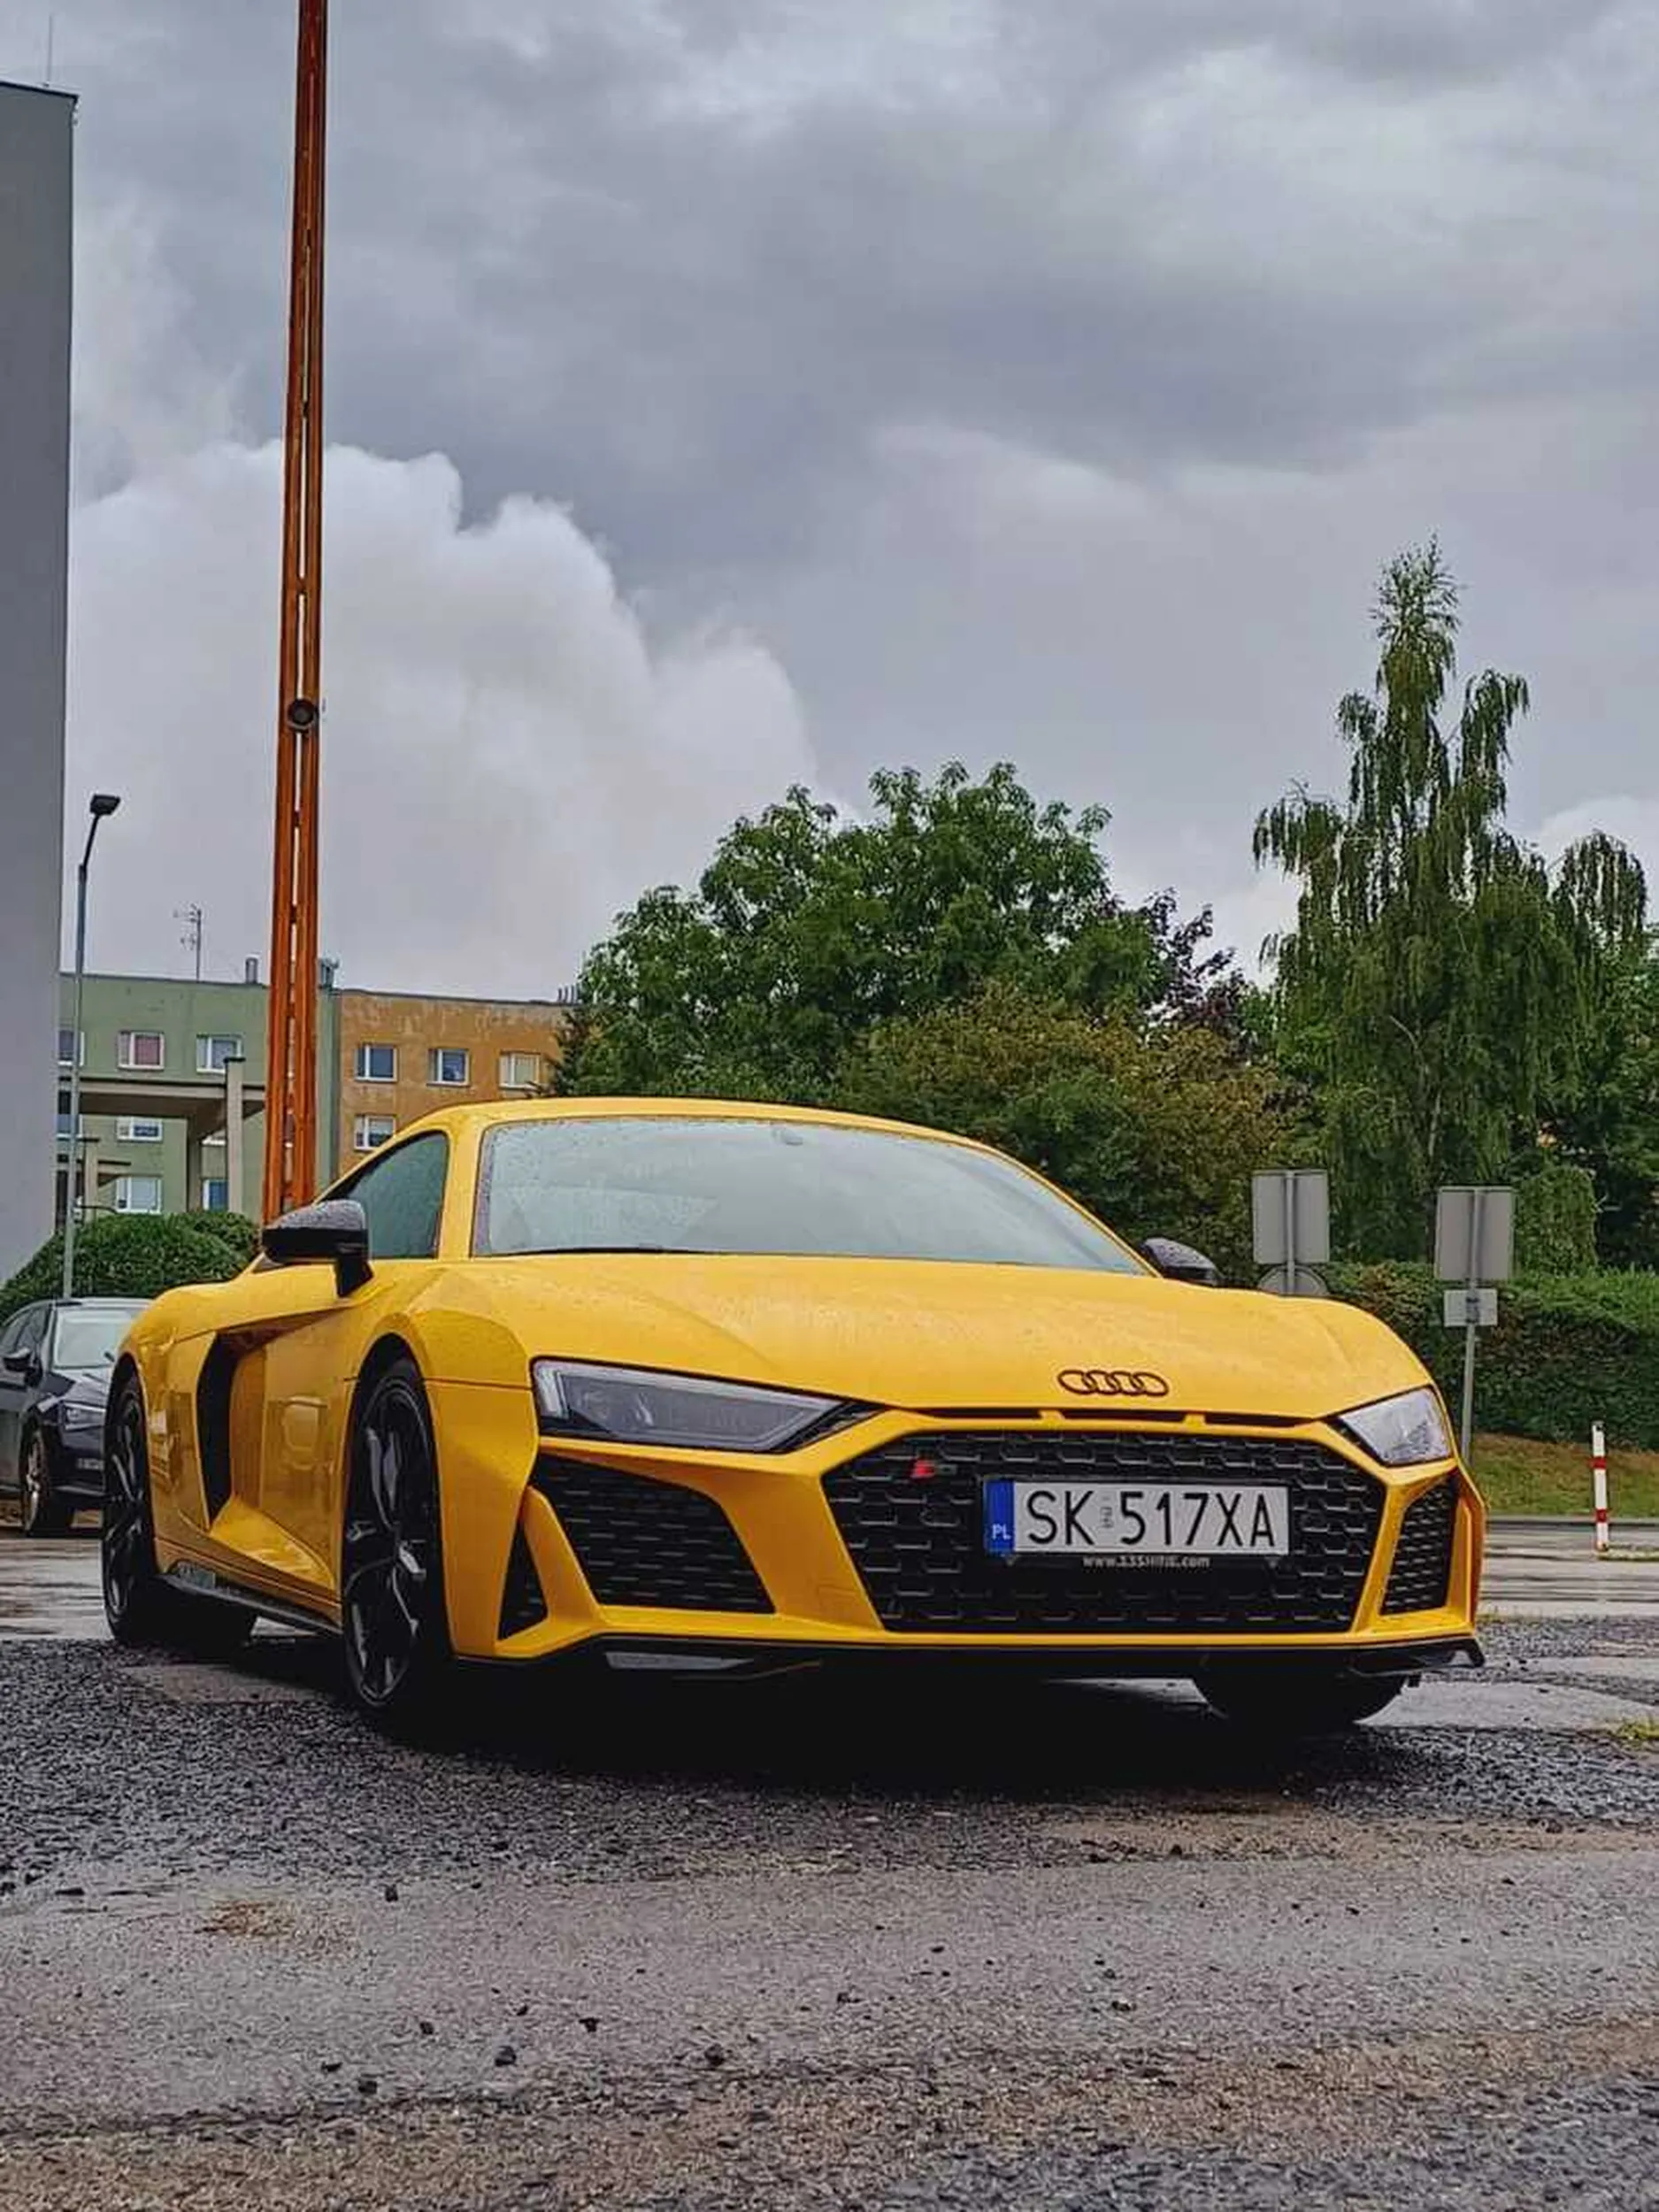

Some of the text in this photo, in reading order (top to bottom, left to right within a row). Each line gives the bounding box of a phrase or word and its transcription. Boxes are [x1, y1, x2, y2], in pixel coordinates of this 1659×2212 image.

[992, 1524, 1011, 1540] PL
[1026, 1490, 1275, 1547] SK 517XA
